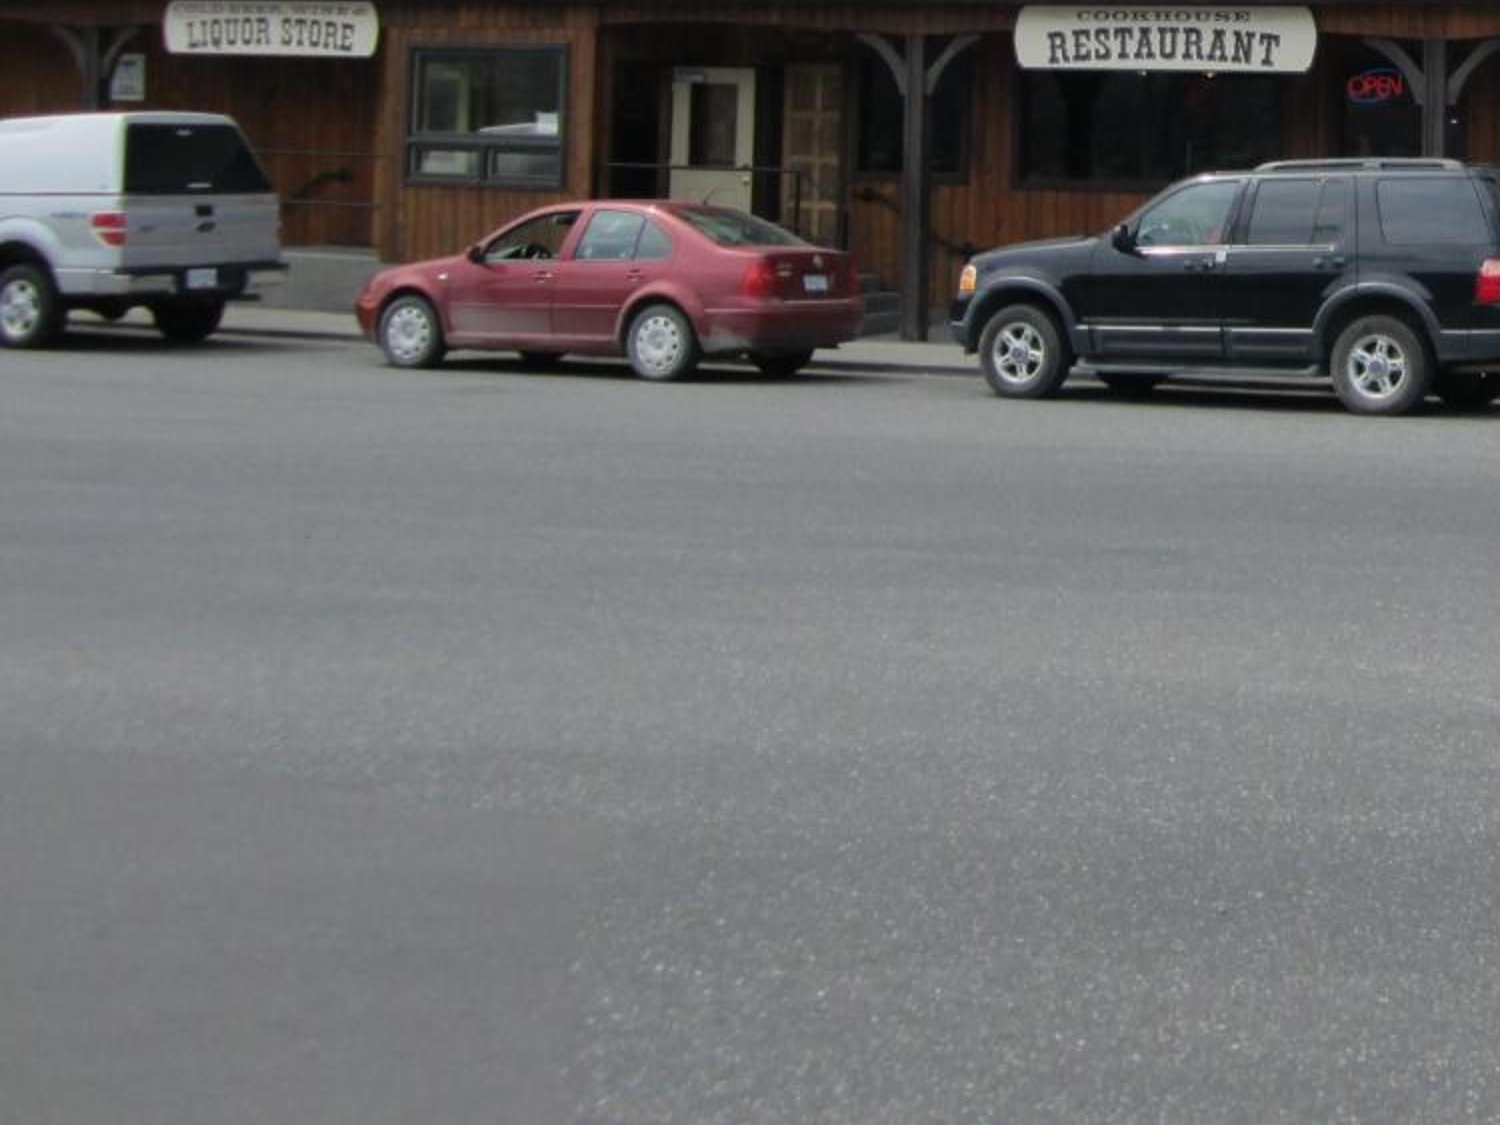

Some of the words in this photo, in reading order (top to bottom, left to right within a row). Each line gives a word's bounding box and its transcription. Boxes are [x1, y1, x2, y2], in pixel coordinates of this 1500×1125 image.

[1075, 9, 1251, 22] COOKHOUSE
[186, 17, 271, 50] LIQUOR
[280, 18, 355, 52] STORE
[1047, 26, 1281, 67] RESTAURANT
[1347, 75, 1403, 99] OPEN
